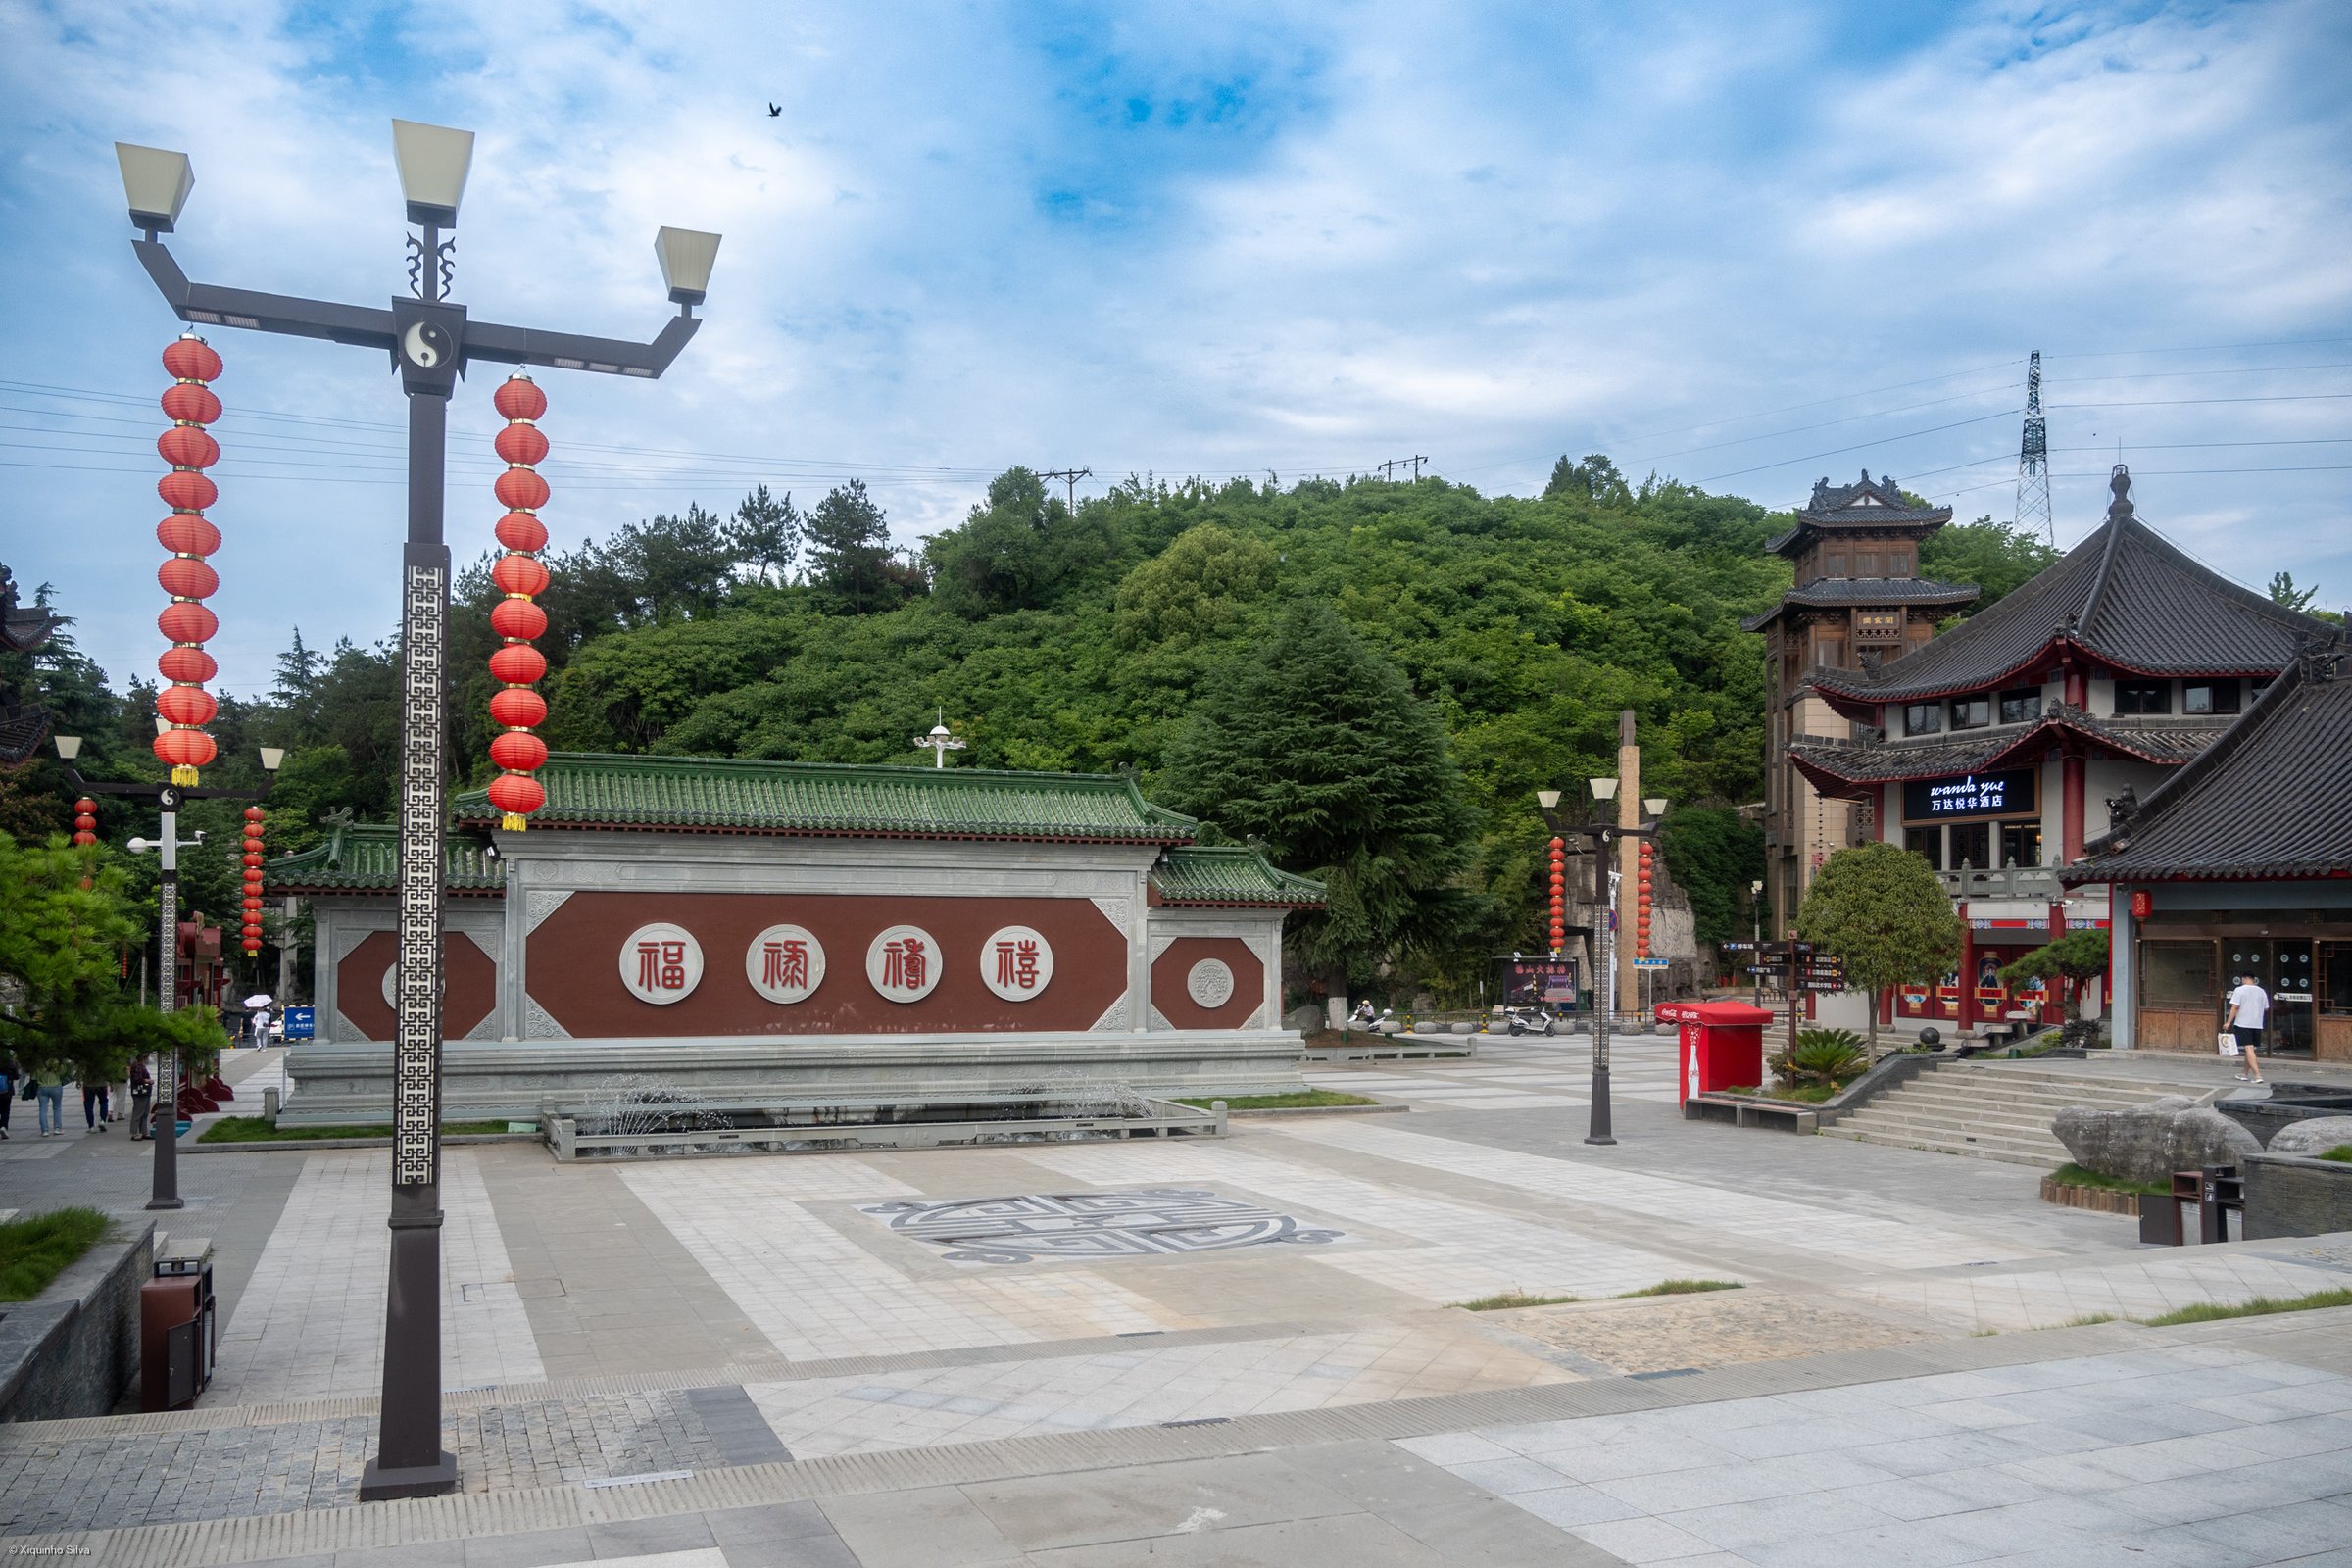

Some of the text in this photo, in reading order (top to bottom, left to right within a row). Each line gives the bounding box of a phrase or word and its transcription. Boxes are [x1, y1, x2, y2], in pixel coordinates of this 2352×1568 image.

[1930, 775, 1977, 797] wanda
[1931, 795, 2004, 811] 万达悦华酒店
[637, 940, 686, 992] 福
